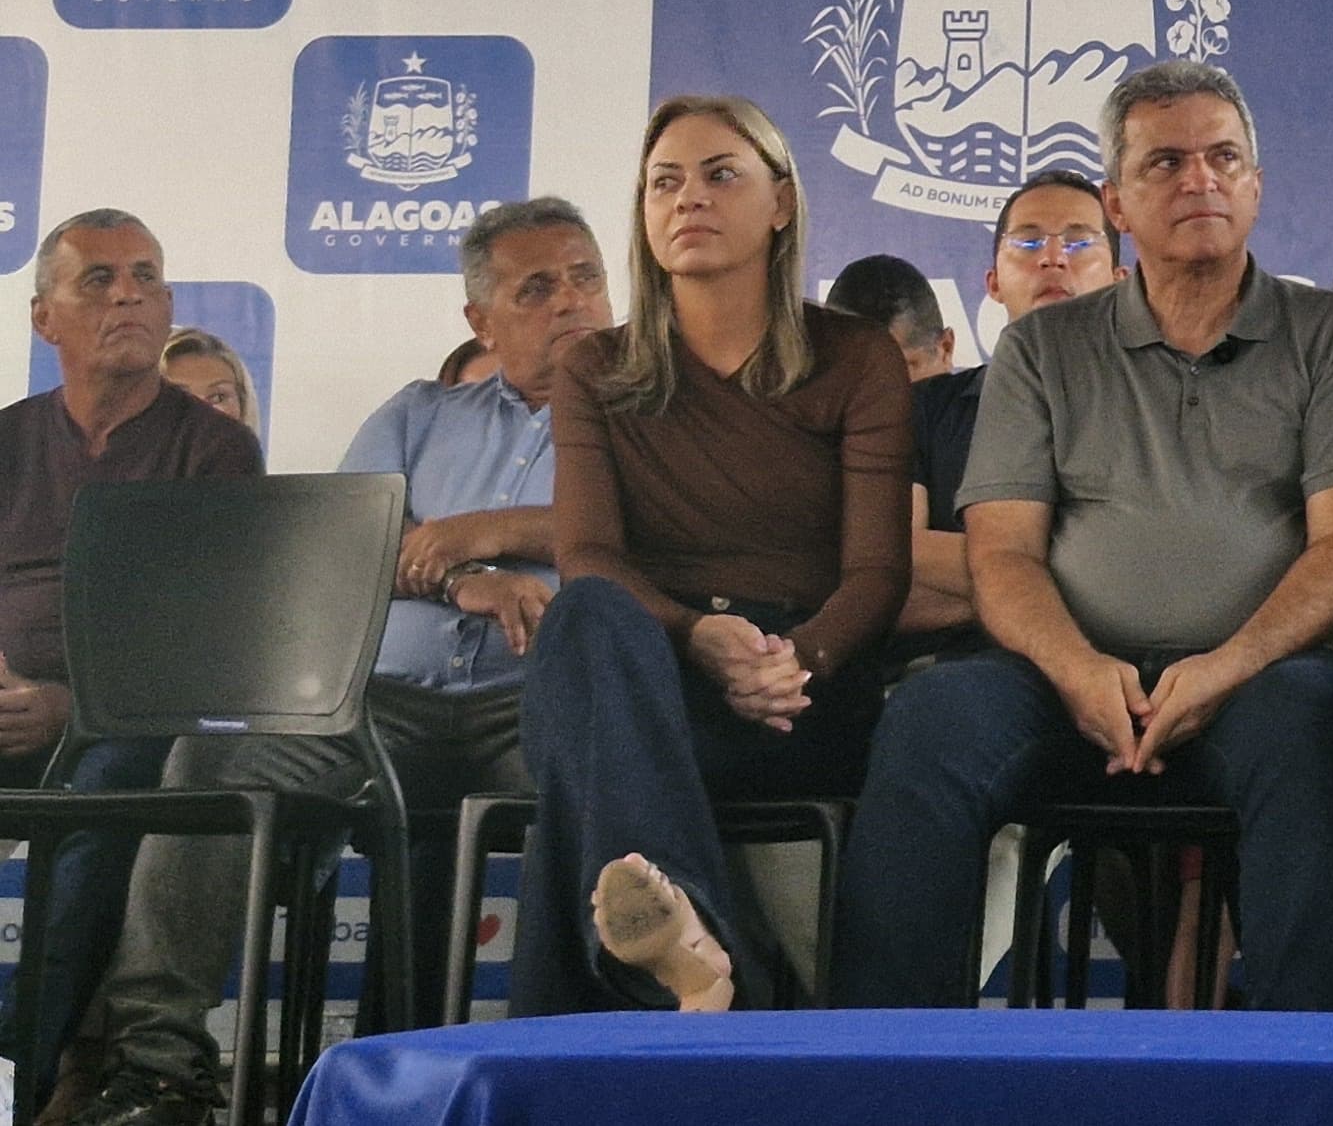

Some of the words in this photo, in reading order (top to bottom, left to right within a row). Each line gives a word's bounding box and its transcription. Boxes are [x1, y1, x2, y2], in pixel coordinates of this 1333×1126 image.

[900, 182, 923, 197] AD
[926, 188, 988, 207] BONUM
[324, 234, 461, 247] GOVERN
